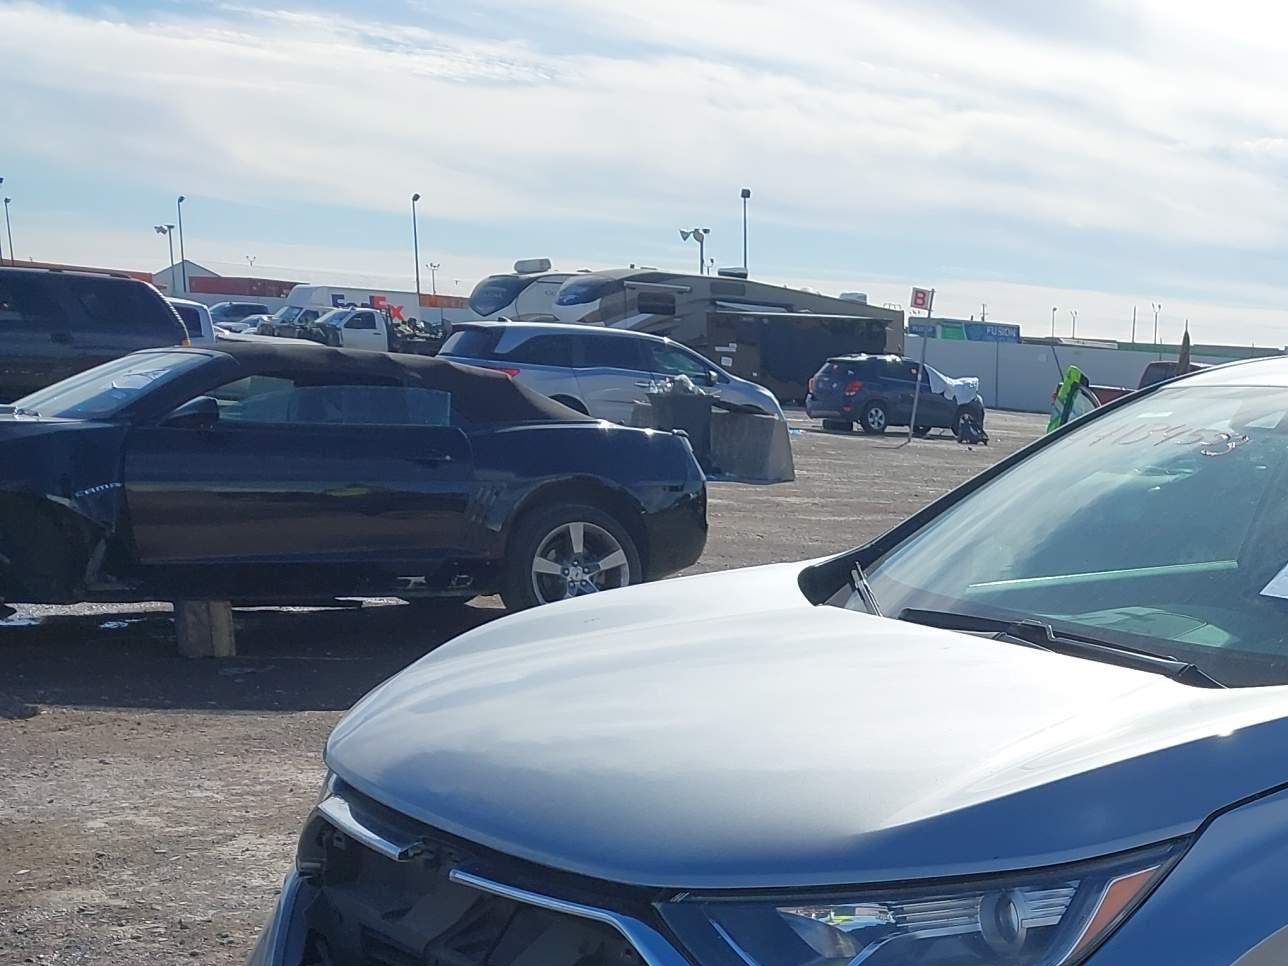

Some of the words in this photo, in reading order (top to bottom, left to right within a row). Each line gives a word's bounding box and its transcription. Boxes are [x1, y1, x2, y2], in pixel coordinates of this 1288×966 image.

[914, 289, 926, 307] B
[331, 294, 405, 322] FEx
[986, 325, 1017, 338] FUSION
